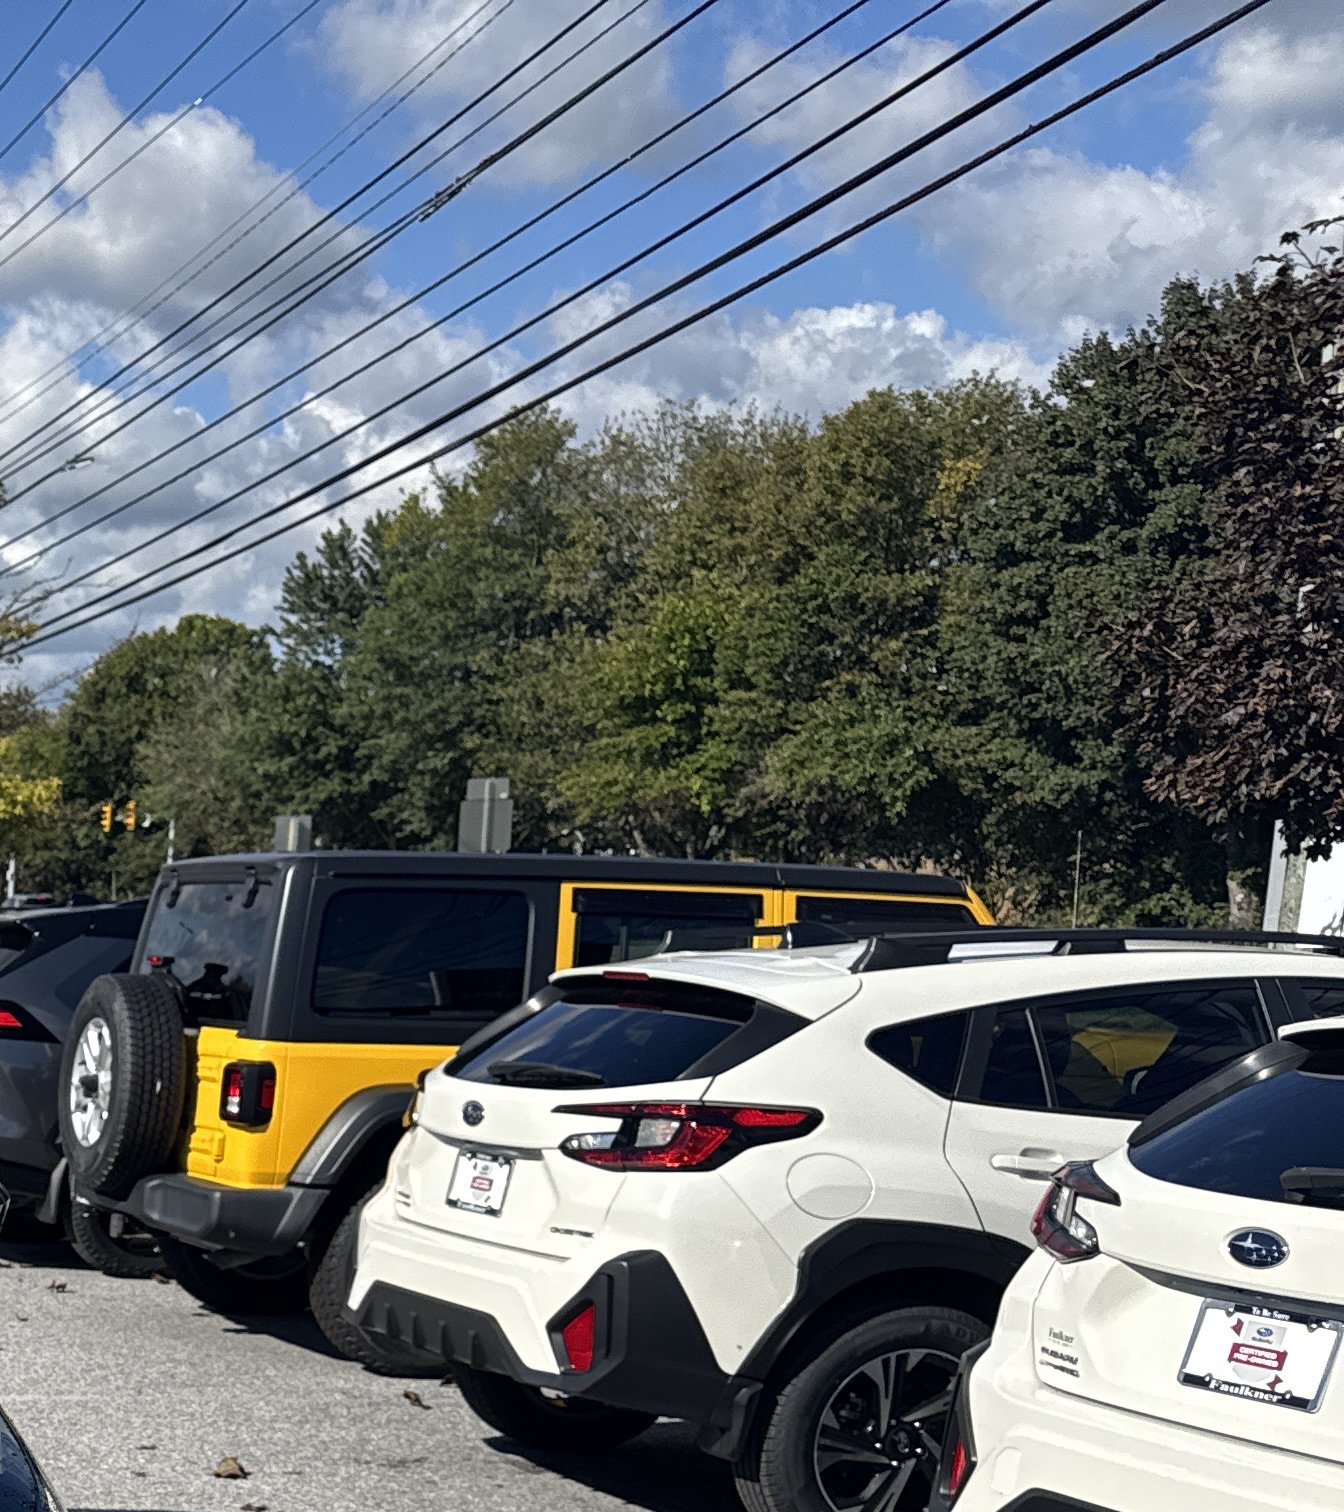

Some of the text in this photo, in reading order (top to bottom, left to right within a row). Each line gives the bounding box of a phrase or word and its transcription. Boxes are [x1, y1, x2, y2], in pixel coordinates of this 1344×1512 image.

[1252, 1306, 1261, 1315] To
[1273, 1311, 1291, 1321] Sure
[1233, 1352, 1279, 1368] PRE-OWNED
[1239, 1346, 1278, 1360] CERTIFIED
[1209, 1379, 1283, 1403] Faulkner
